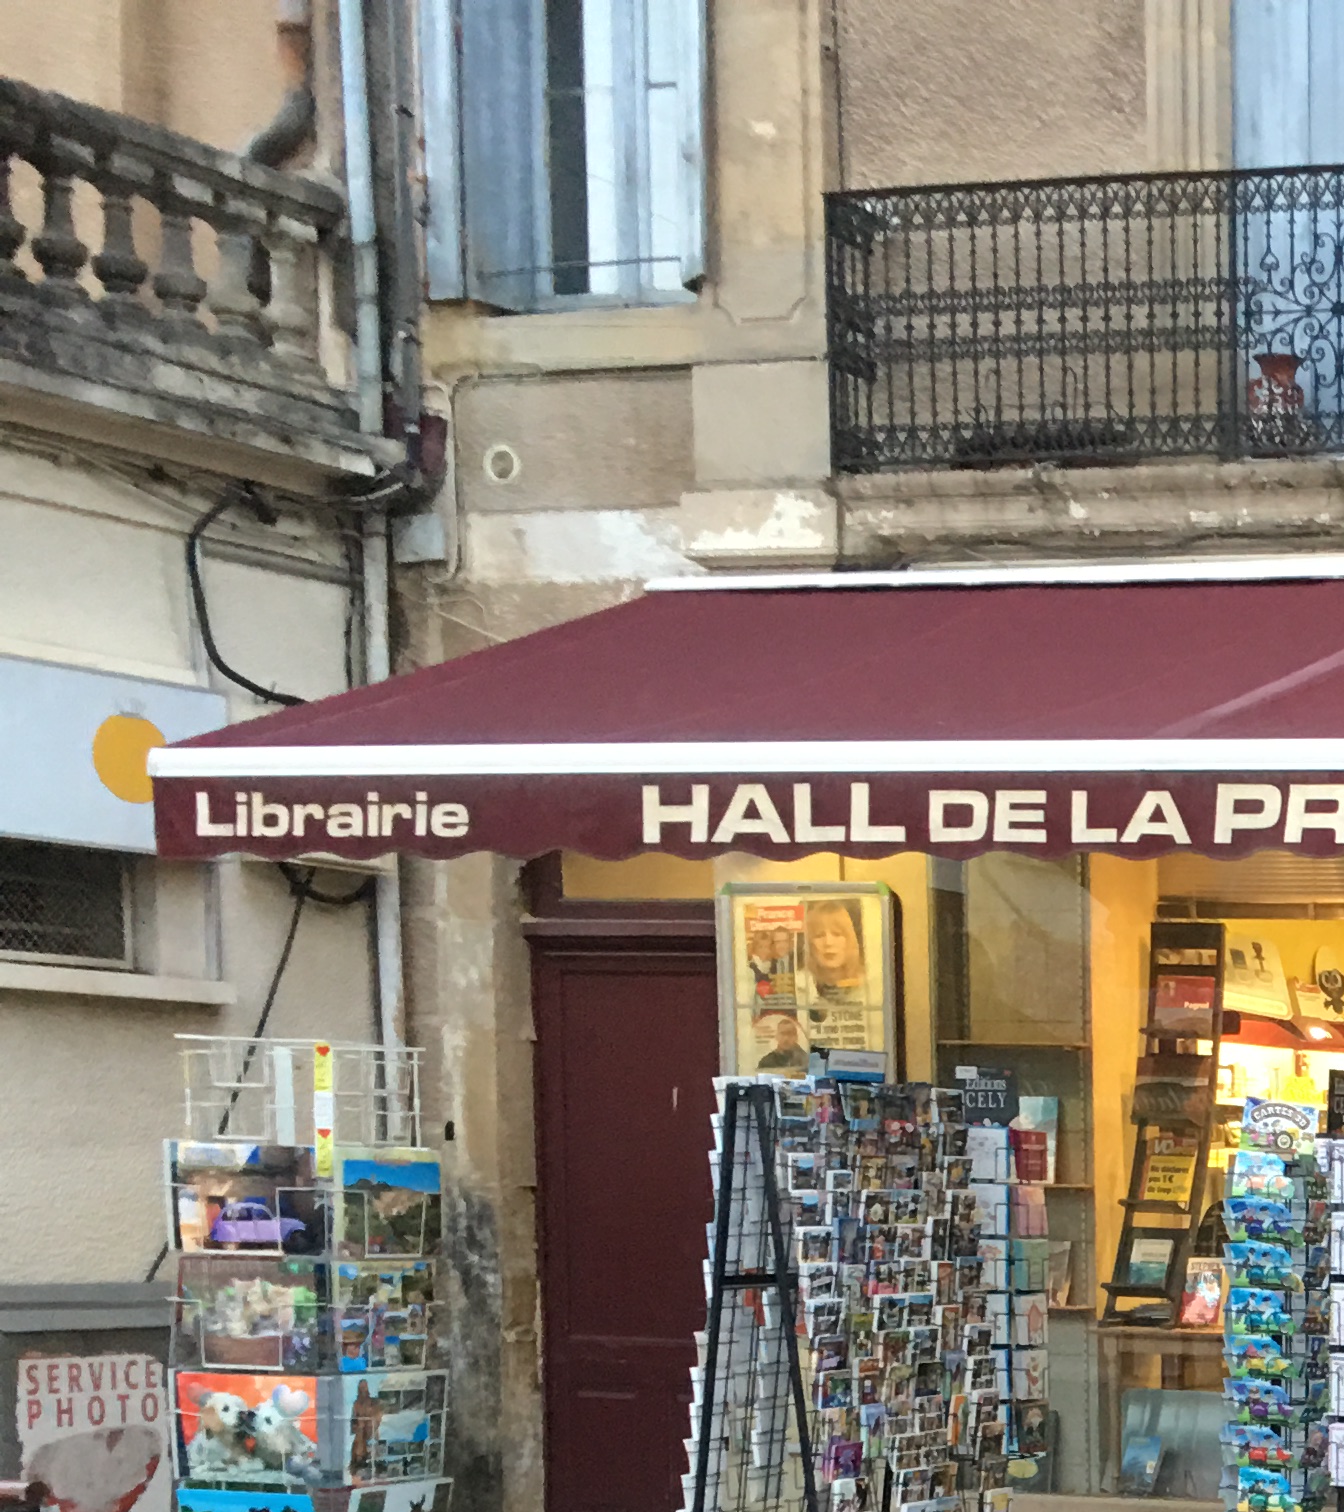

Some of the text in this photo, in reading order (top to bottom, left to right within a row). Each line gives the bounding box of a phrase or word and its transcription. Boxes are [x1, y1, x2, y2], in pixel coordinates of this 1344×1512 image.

[195, 790, 470, 838] Librairie
[642, 782, 906, 844] HALL
[928, 789, 1047, 844] DE
[1071, 790, 1192, 844] LA
[966, 1091, 1007, 1108] CELY
[1253, 1106, 1294, 1121] CARTES
[25, 1358, 159, 1396] SERVICE
[26, 1392, 160, 1430] PHOTO
